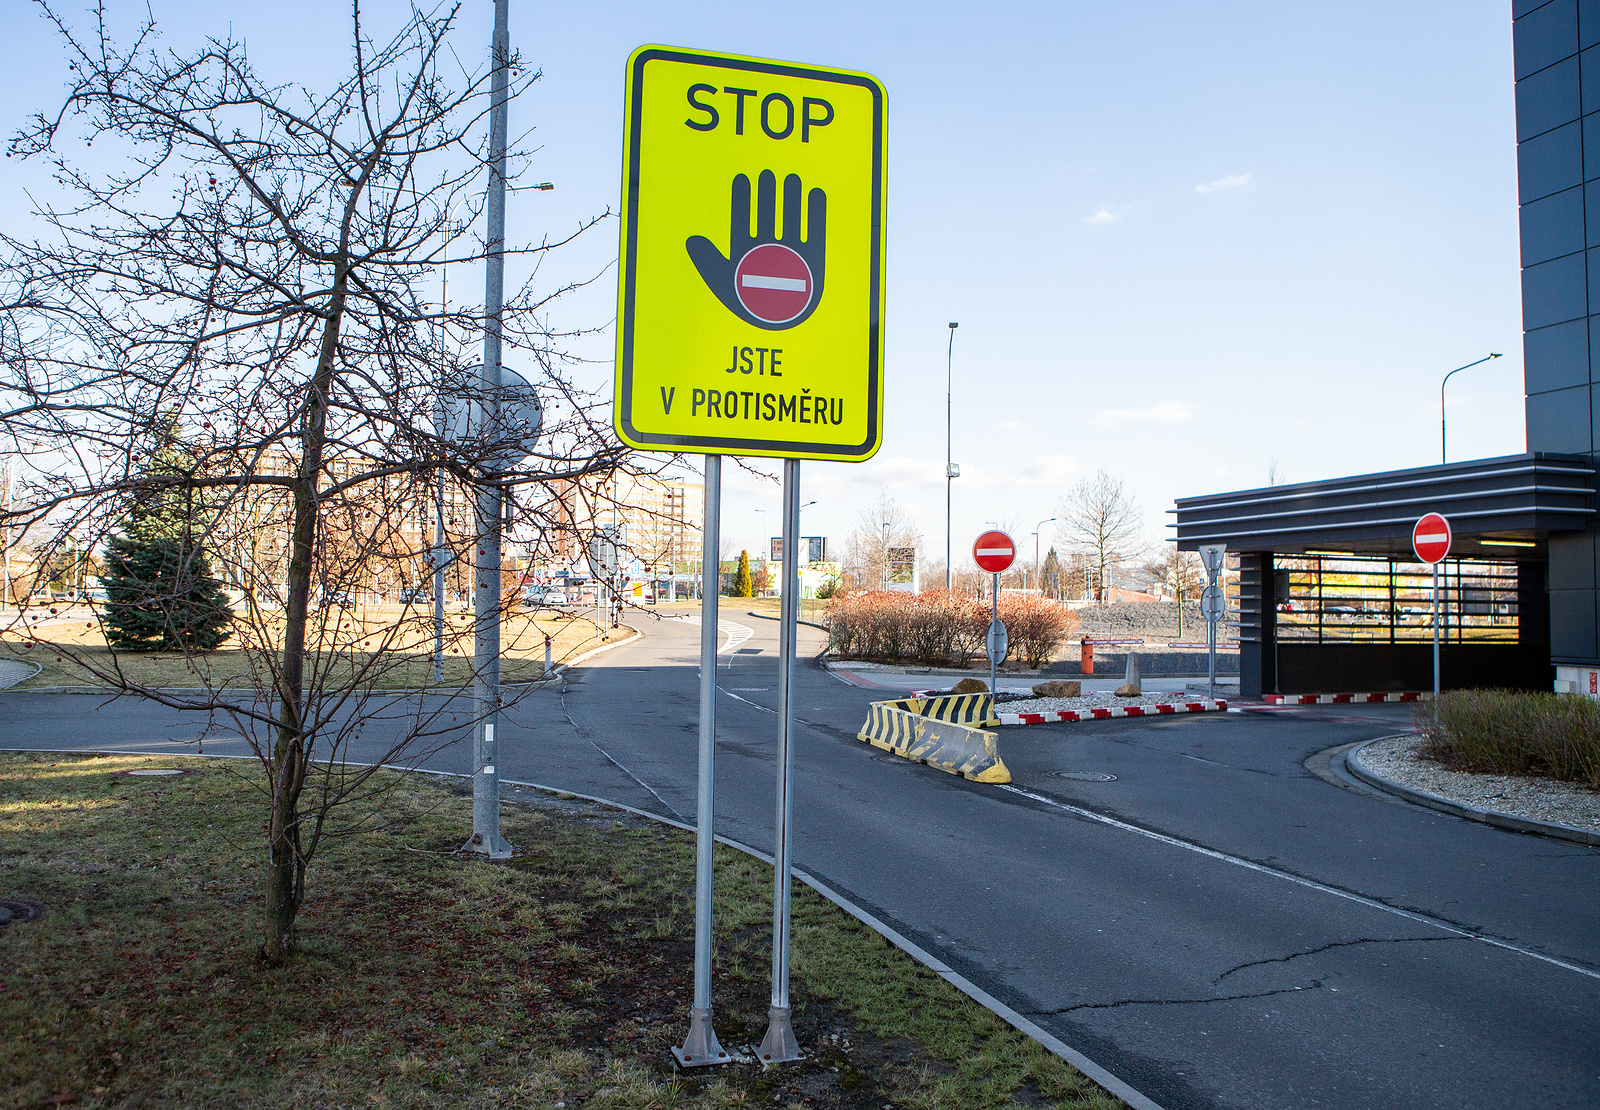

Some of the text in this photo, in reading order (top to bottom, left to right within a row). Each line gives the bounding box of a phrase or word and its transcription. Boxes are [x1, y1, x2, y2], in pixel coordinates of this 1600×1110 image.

[685, 83, 834, 143] STOP
[725, 346, 783, 377] JSTE
[660, 386, 843, 425] V PROTISMĚRU
